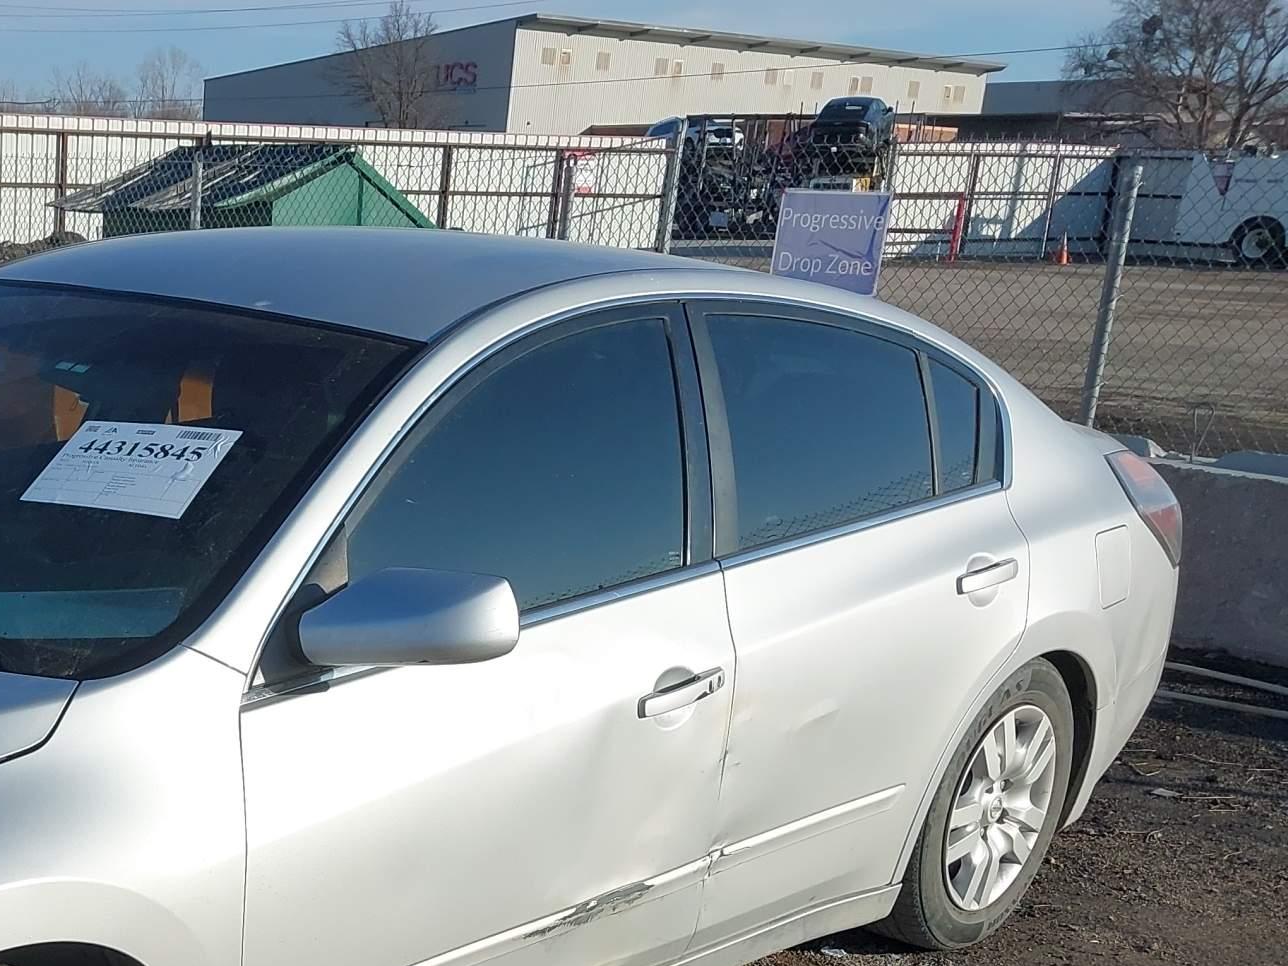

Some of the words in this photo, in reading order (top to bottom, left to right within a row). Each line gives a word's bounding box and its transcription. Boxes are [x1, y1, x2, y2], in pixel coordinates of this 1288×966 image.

[780, 207, 885, 232] Progressive
[778, 251, 822, 277] Drop
[825, 254, 873, 275] Zone
[78, 438, 209, 463] 44315845
